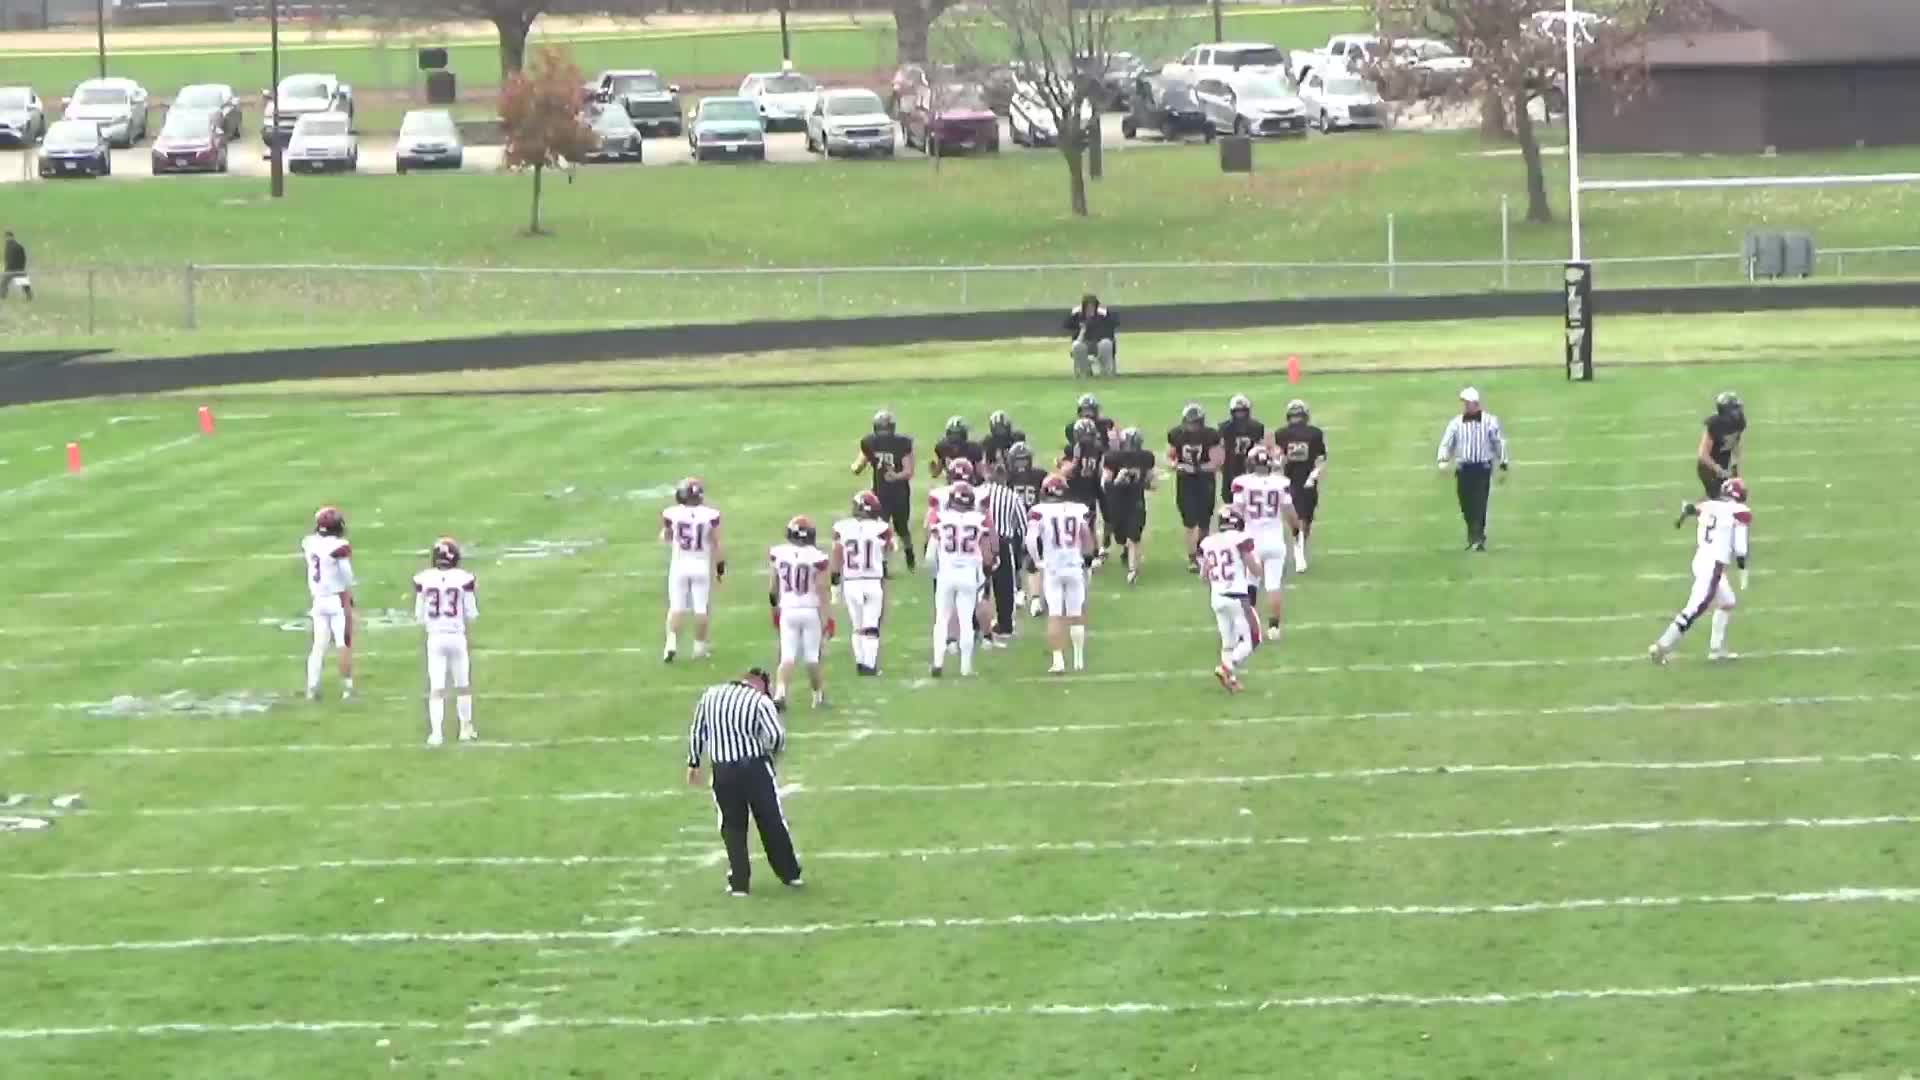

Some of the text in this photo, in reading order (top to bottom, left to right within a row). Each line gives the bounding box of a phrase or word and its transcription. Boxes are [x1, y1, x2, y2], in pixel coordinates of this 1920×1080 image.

[1249, 490, 1279, 519] 59
[676, 524, 704, 552] 51
[942, 523, 978, 553] 32
[1050, 516, 1077, 548] 19
[1704, 514, 1717, 544] 2
[845, 538, 874, 569] 21
[1206, 548, 1235, 581] 22
[426, 587, 460, 619] 33
